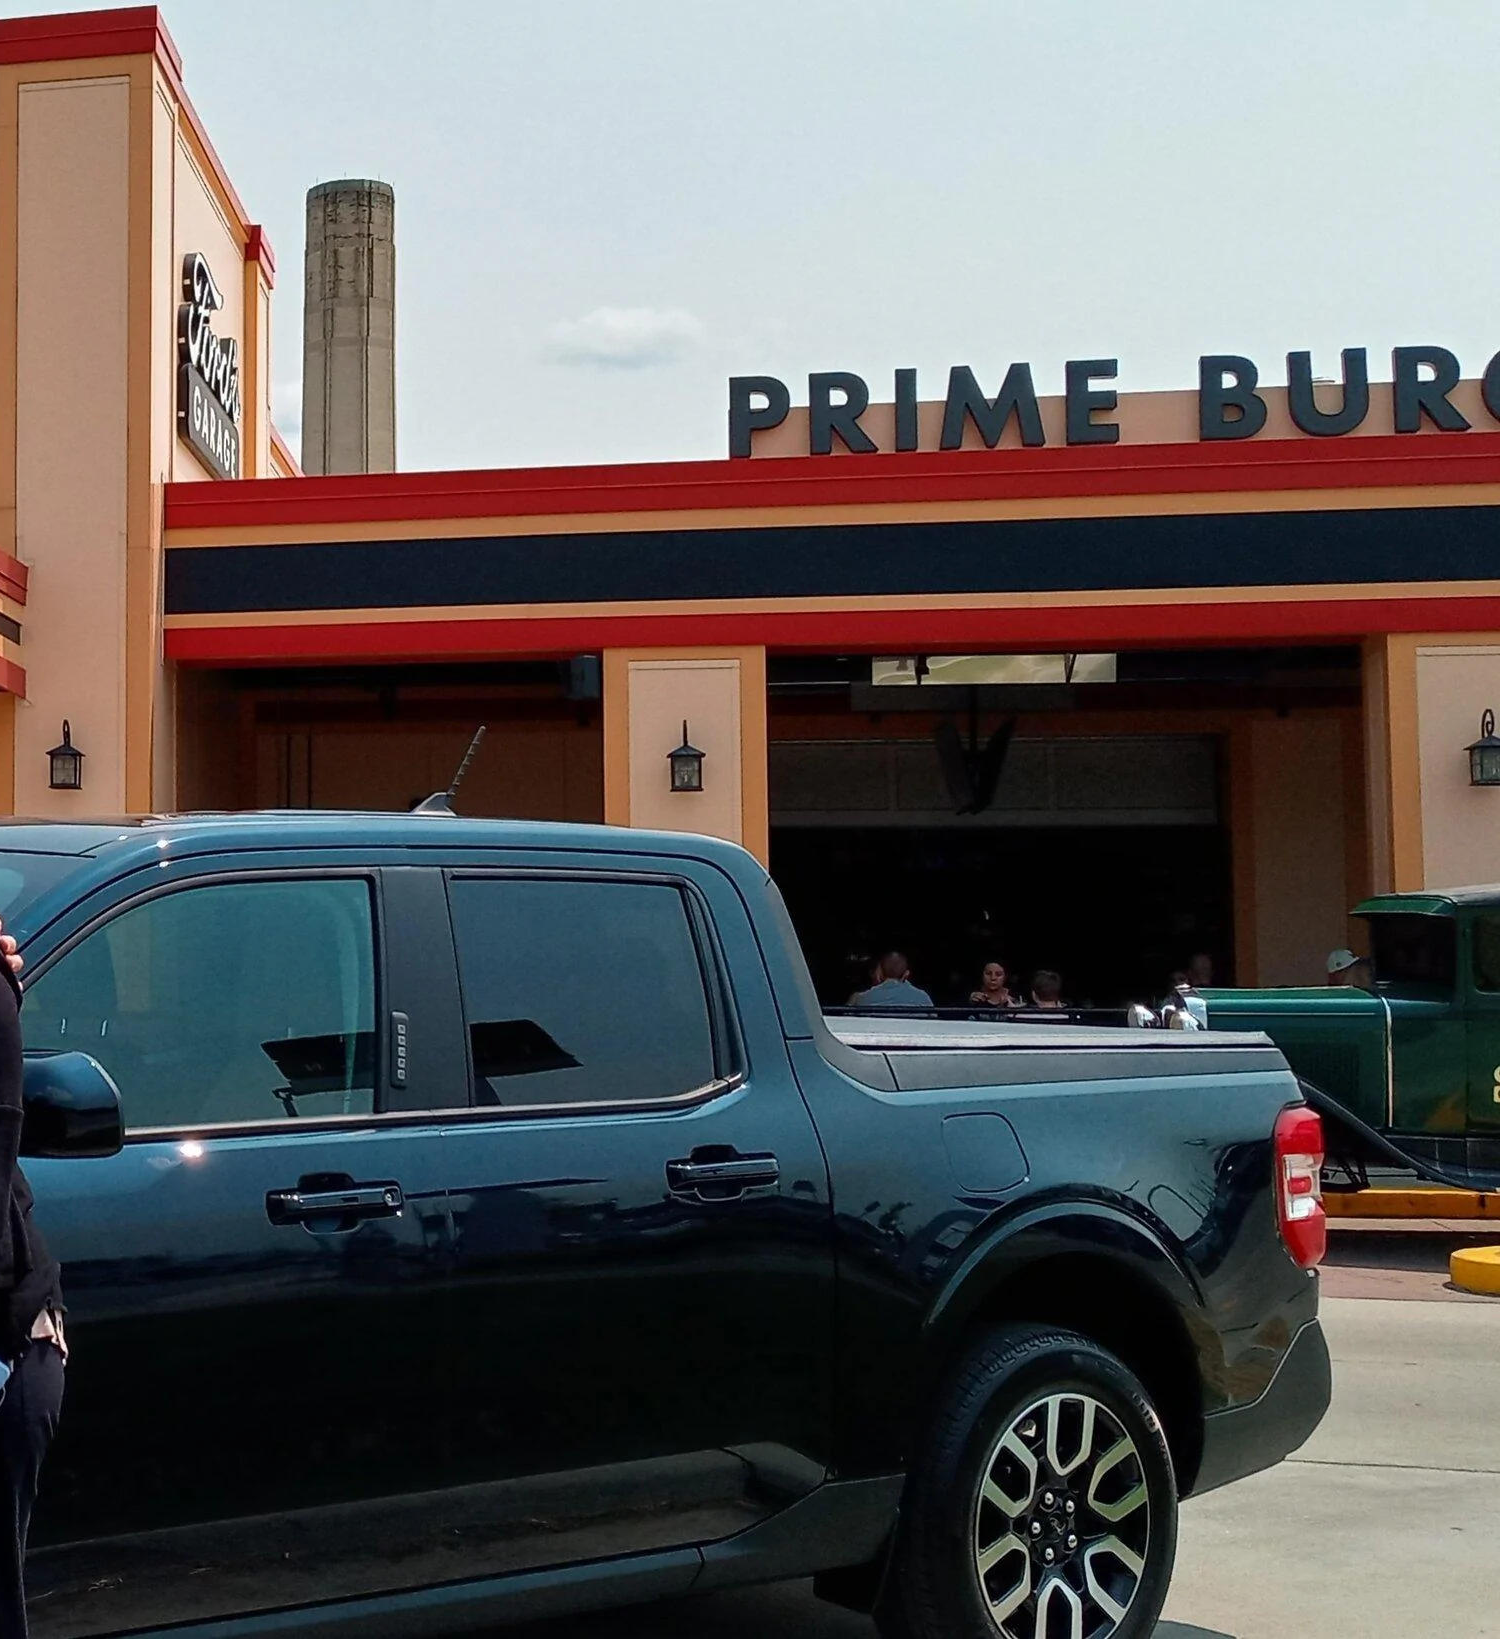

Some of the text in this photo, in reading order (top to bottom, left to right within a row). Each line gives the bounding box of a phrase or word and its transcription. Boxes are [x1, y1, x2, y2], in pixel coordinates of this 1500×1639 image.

[192, 385, 237, 480] GARAGE
[728, 345, 1500, 458] PRIME BUR
